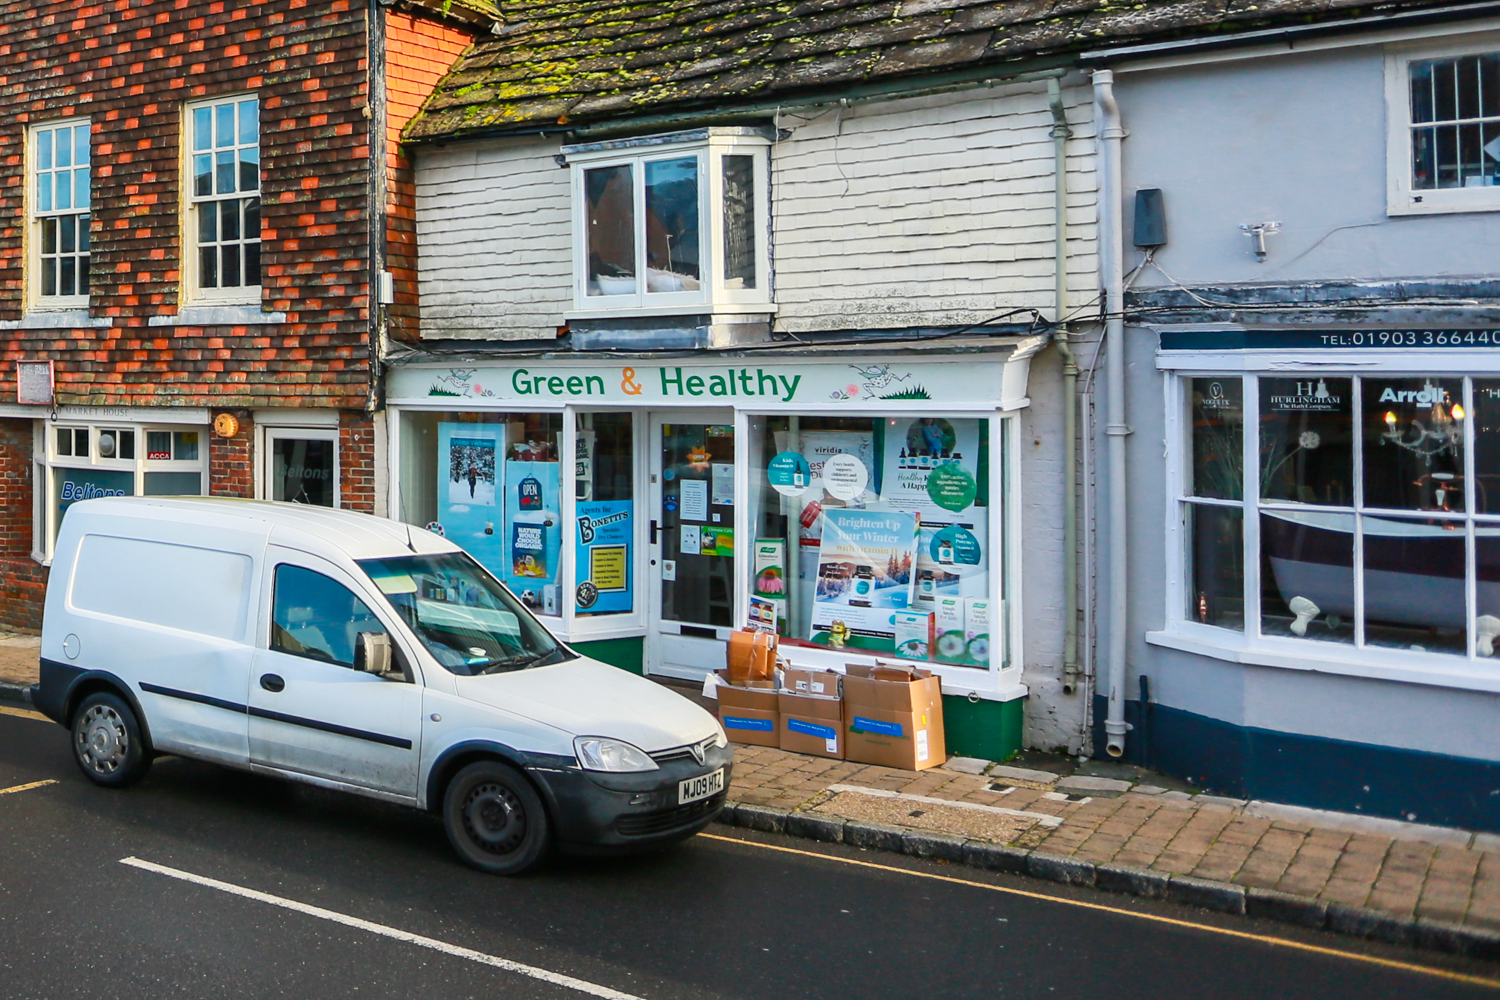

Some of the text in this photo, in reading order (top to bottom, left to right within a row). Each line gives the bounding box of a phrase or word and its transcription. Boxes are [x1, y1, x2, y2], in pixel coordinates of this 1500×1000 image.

[1422, 331, 1500, 345] 366440
[512, 366, 802, 402] Green & Healthy
[1270, 396, 1340, 404] HURLINGHAM
[1379, 387, 1445, 404] Arroll
[66, 408, 98, 416] MARKET
[103, 408, 129, 417] HOUSE
[277, 464, 329, 480] Beltons
[523, 483, 538, 496] OPEN
[581, 507, 601, 515] Agents
[838, 517, 901, 531] Brighten Up
[518, 527, 542, 535] NATURE
[838, 531, 900, 543] Your Winter
[515, 542, 543, 550] ORGANIC
[836, 544, 855, 552] with
[857, 546, 889, 554] vitamin
[683, 771, 722, 800] MJ09 HTZ
